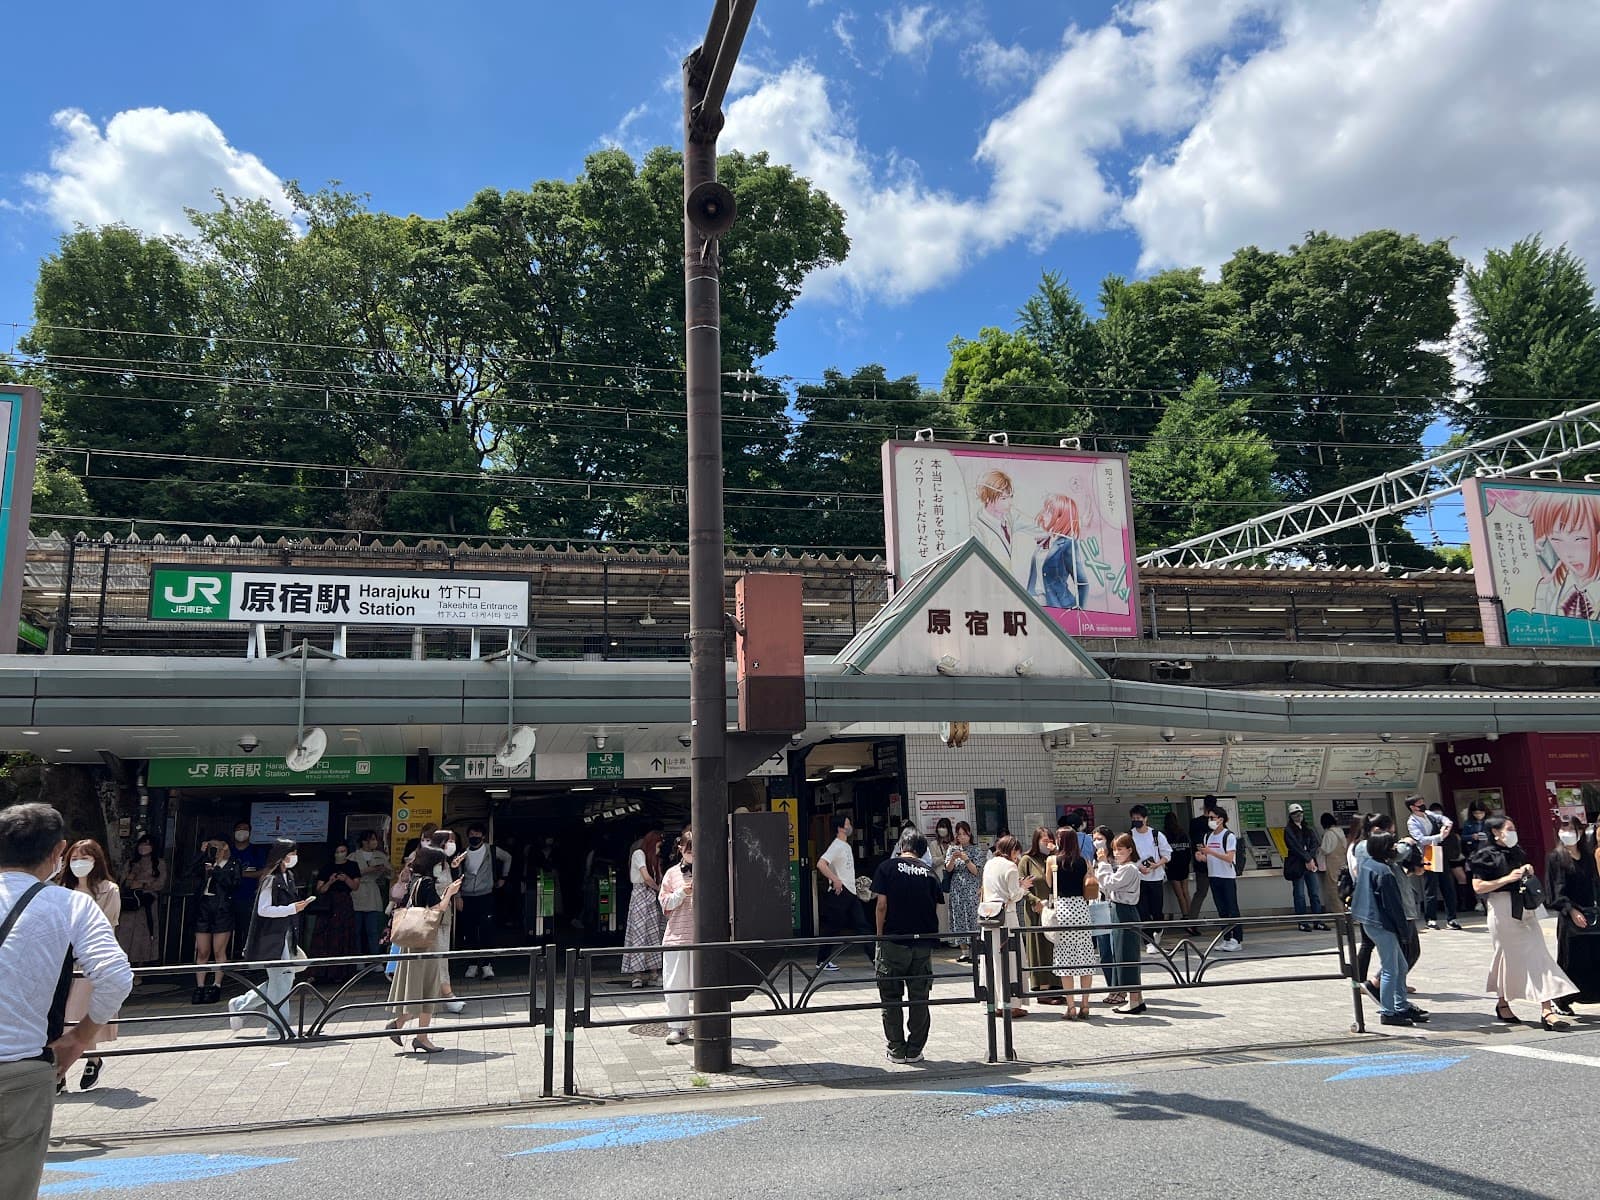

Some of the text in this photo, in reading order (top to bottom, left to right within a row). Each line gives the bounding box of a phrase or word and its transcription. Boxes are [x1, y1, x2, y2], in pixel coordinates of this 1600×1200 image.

[912, 457, 929, 558] パスワードだけだぜ
[930, 458, 947, 555] 本当にお前を守れ
[1505, 521, 1520, 576] パスワードの
[164, 576, 222, 605] JR
[239, 582, 350, 614] 原宿駅
[359, 584, 430, 602] Harajuku
[438, 585, 481, 599] 竹下口
[170, 605, 213, 614] JR東日本
[359, 601, 415, 616] Station
[437, 601, 518, 611] Takeshita Entrance
[926, 608, 1028, 636] 原宿駅
[1081, 623, 1095, 632] IPA
[600, 754, 614, 762] JR
[1454, 752, 1492, 767] COSTA
[188, 763, 209, 774] JR
[214, 763, 261, 777] 原宿駅
[589, 765, 624, 775] 竹下改札
